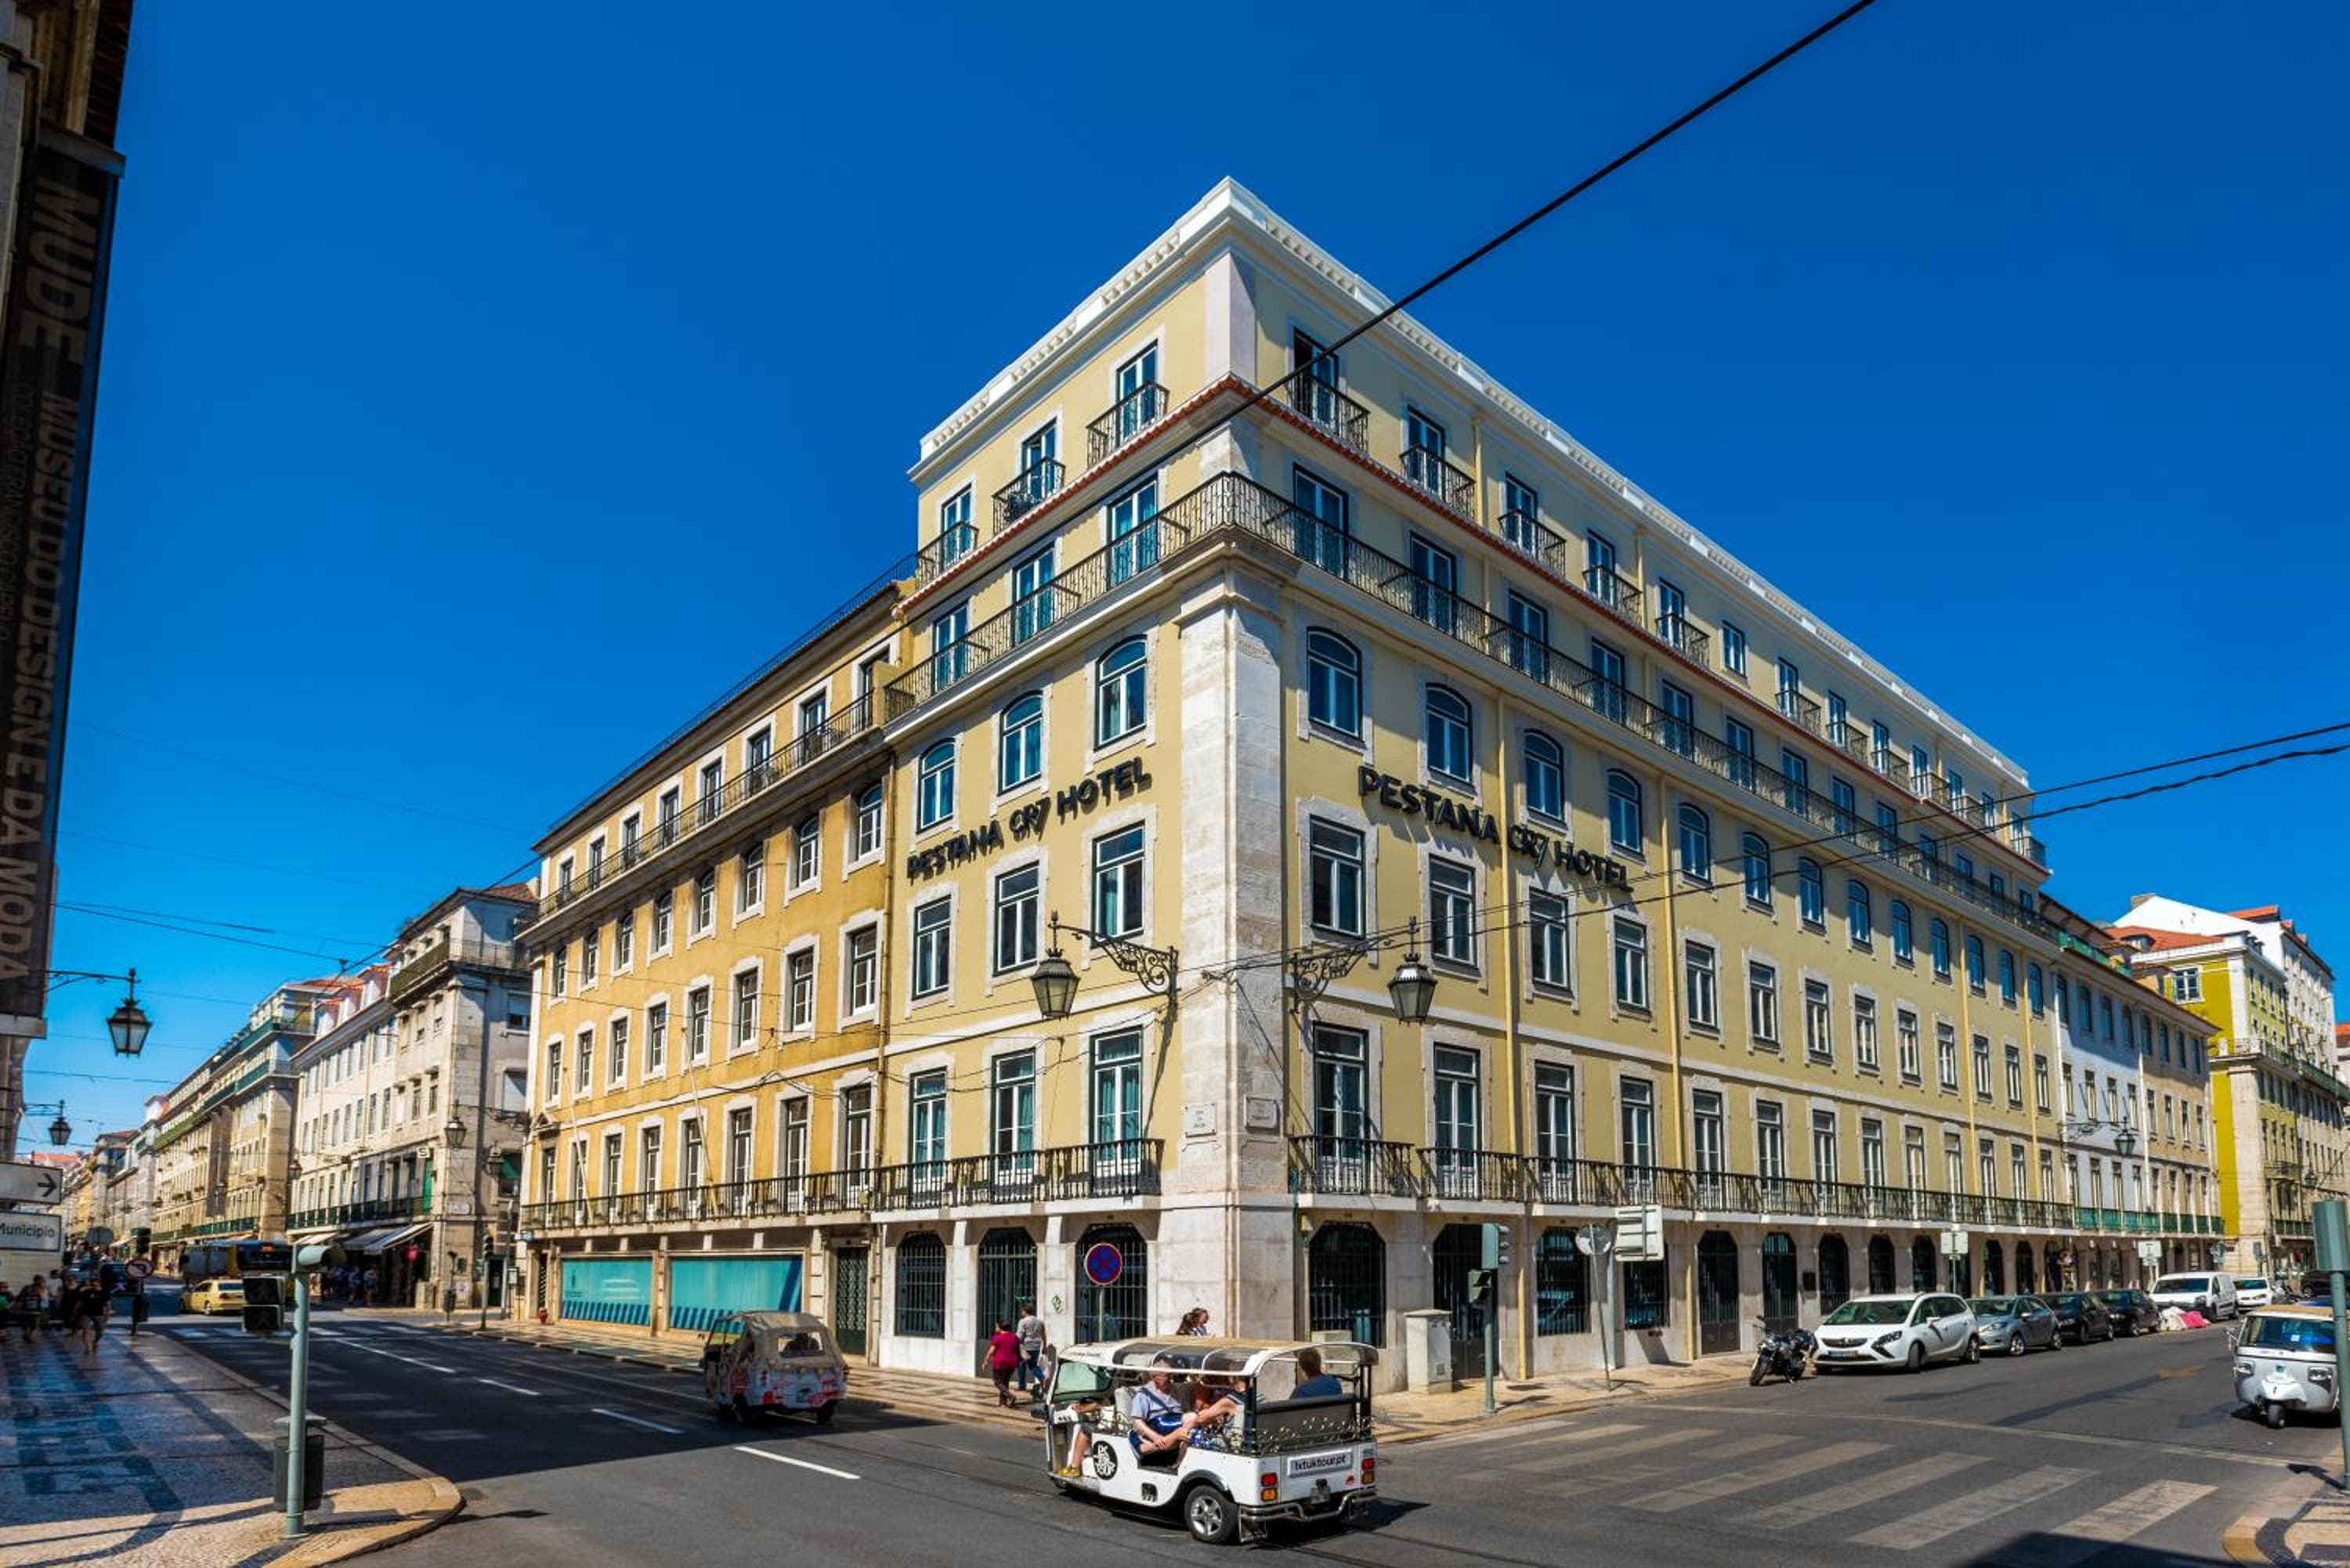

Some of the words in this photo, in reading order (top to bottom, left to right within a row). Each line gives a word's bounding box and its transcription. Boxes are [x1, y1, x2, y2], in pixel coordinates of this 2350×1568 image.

[18, 174, 101, 365] MUDE
[31, 389, 78, 526] MUSEU
[24, 527, 66, 591] DO
[9, 594, 62, 747] DESIGN
[0, 786, 45, 846] DA
[5, 752, 47, 784] E
[907, 820, 1004, 885] PESTANA
[1010, 797, 1051, 841] CR7
[1057, 757, 1152, 824] HOTEL
[1358, 766, 1500, 844] PESTANA
[1508, 824, 1549, 868] CR7
[1554, 840, 1633, 893] HOTEL
[0, 856, 39, 981] MODA
